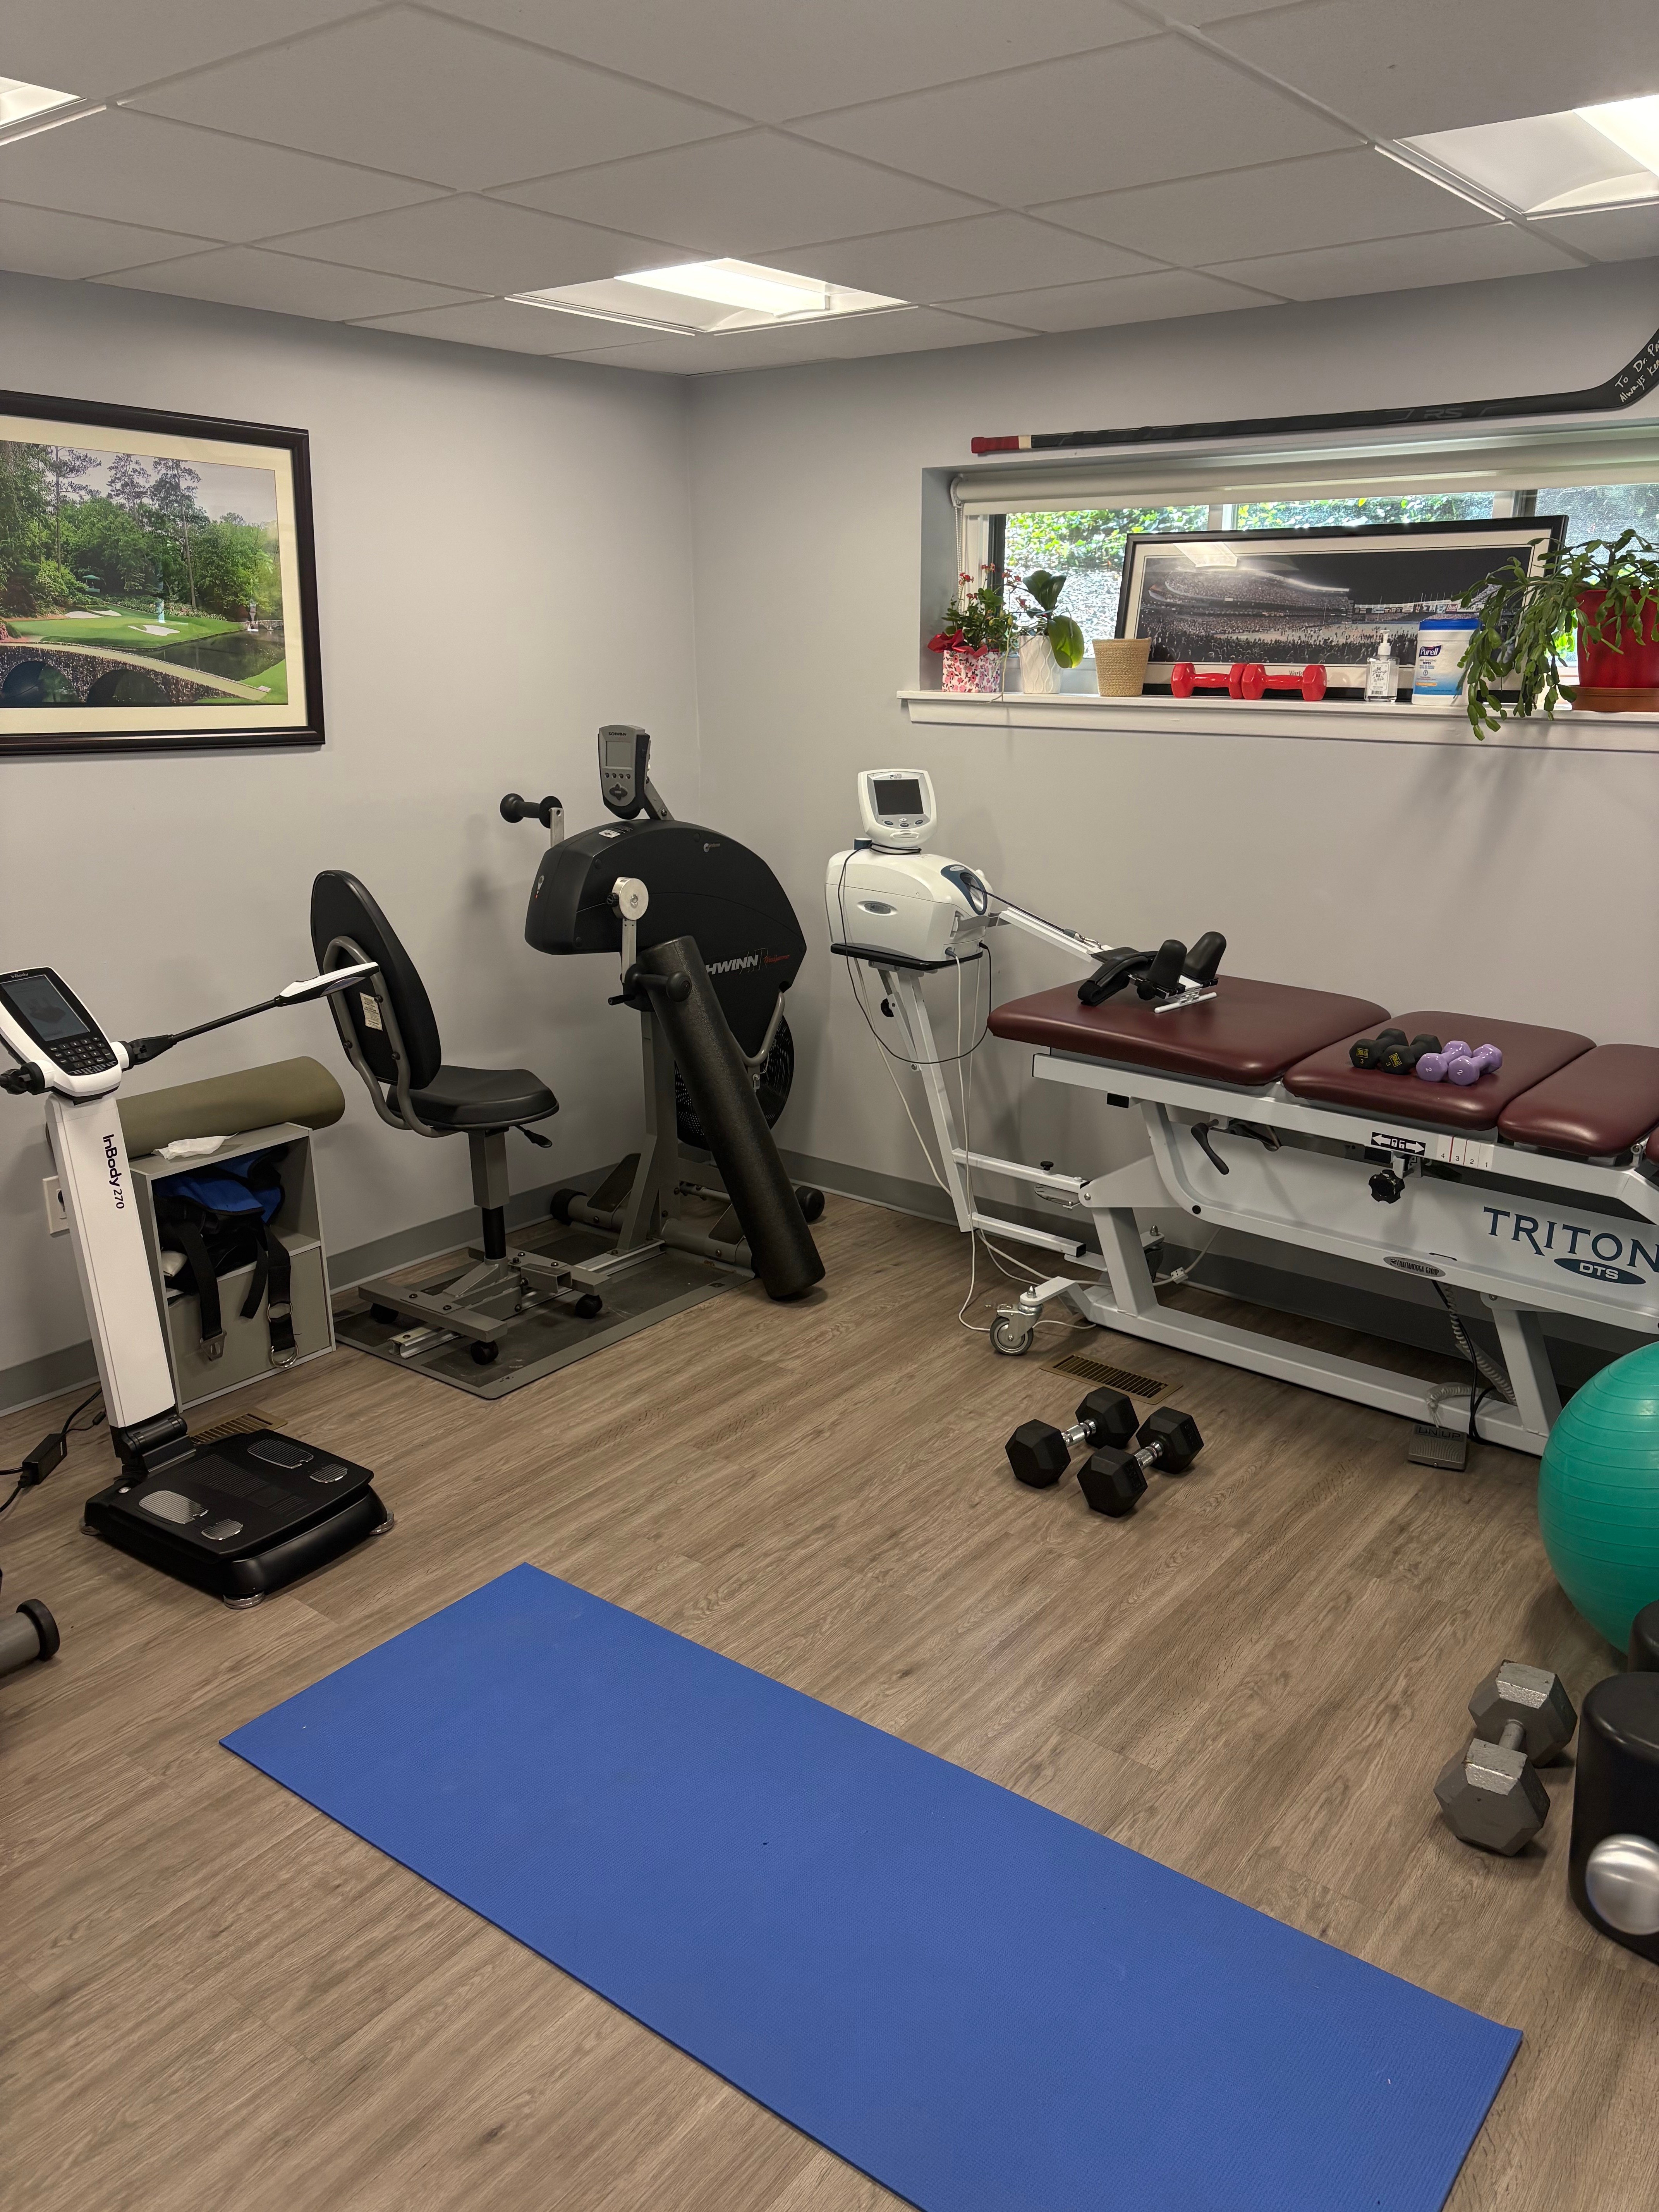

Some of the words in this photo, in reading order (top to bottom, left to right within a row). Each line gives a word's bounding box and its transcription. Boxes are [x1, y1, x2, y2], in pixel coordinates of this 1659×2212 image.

[1615, 375, 1628, 387] To
[1633, 358, 1647, 372] Dr.
[1620, 375, 1645, 402] Always
[1424, 407, 1464, 419] RS
[1420, 647, 1439, 655] Purell
[705, 955, 758, 975] HWINN
[103, 1134, 122, 1187] InBody
[113, 1188, 125, 1209] 270
[1483, 1206, 1659, 1273] TRITON
[1397, 1260, 1424, 1273] CHATTANOOGA
[1425, 1267, 1439, 1276] GROUP
[1579, 1262, 1619, 1280] DTS
